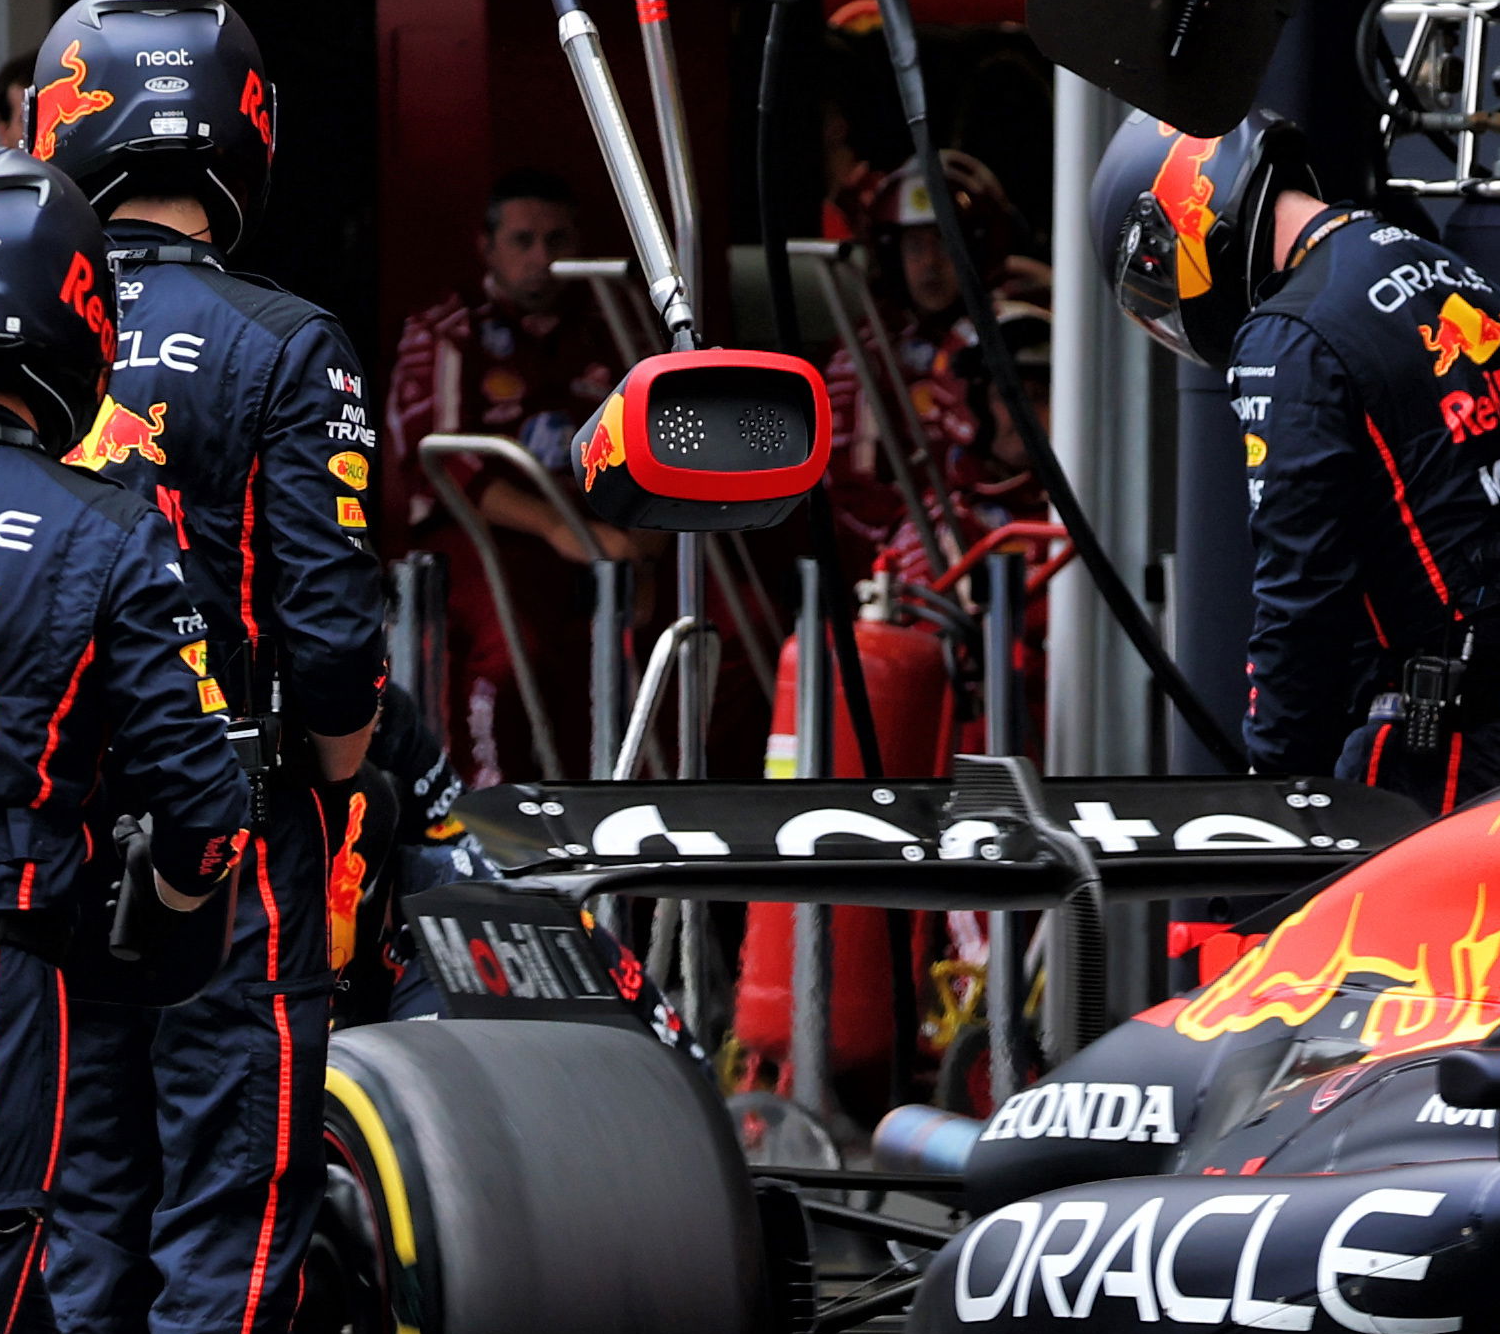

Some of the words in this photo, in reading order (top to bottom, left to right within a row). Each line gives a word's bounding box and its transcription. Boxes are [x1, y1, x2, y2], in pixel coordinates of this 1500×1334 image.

[136, 48, 194, 67] neat.
[418, 915, 568, 1000] Mobil
[980, 1082, 1181, 1145] HONDA
